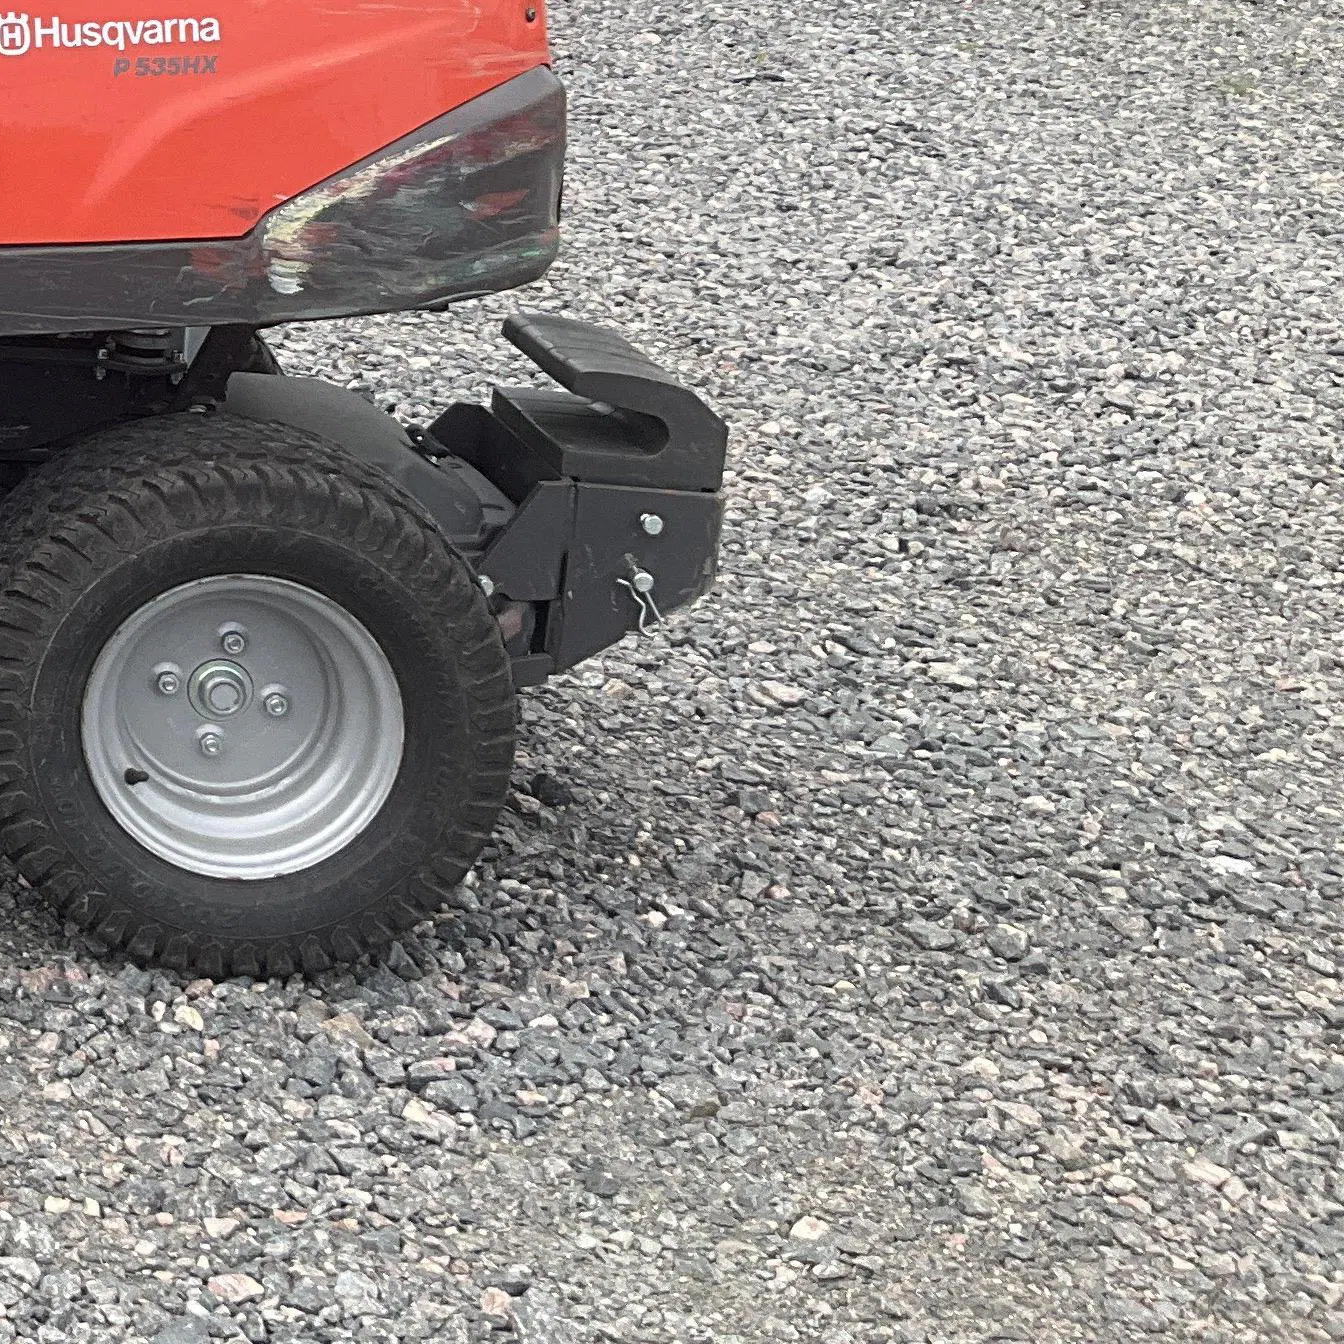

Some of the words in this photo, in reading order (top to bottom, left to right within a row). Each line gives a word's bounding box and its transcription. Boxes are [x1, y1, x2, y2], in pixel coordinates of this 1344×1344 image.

[34, 15, 221, 51] Husqvarna
[113, 58, 131, 77] P
[135, 55, 218, 76] 535HX
